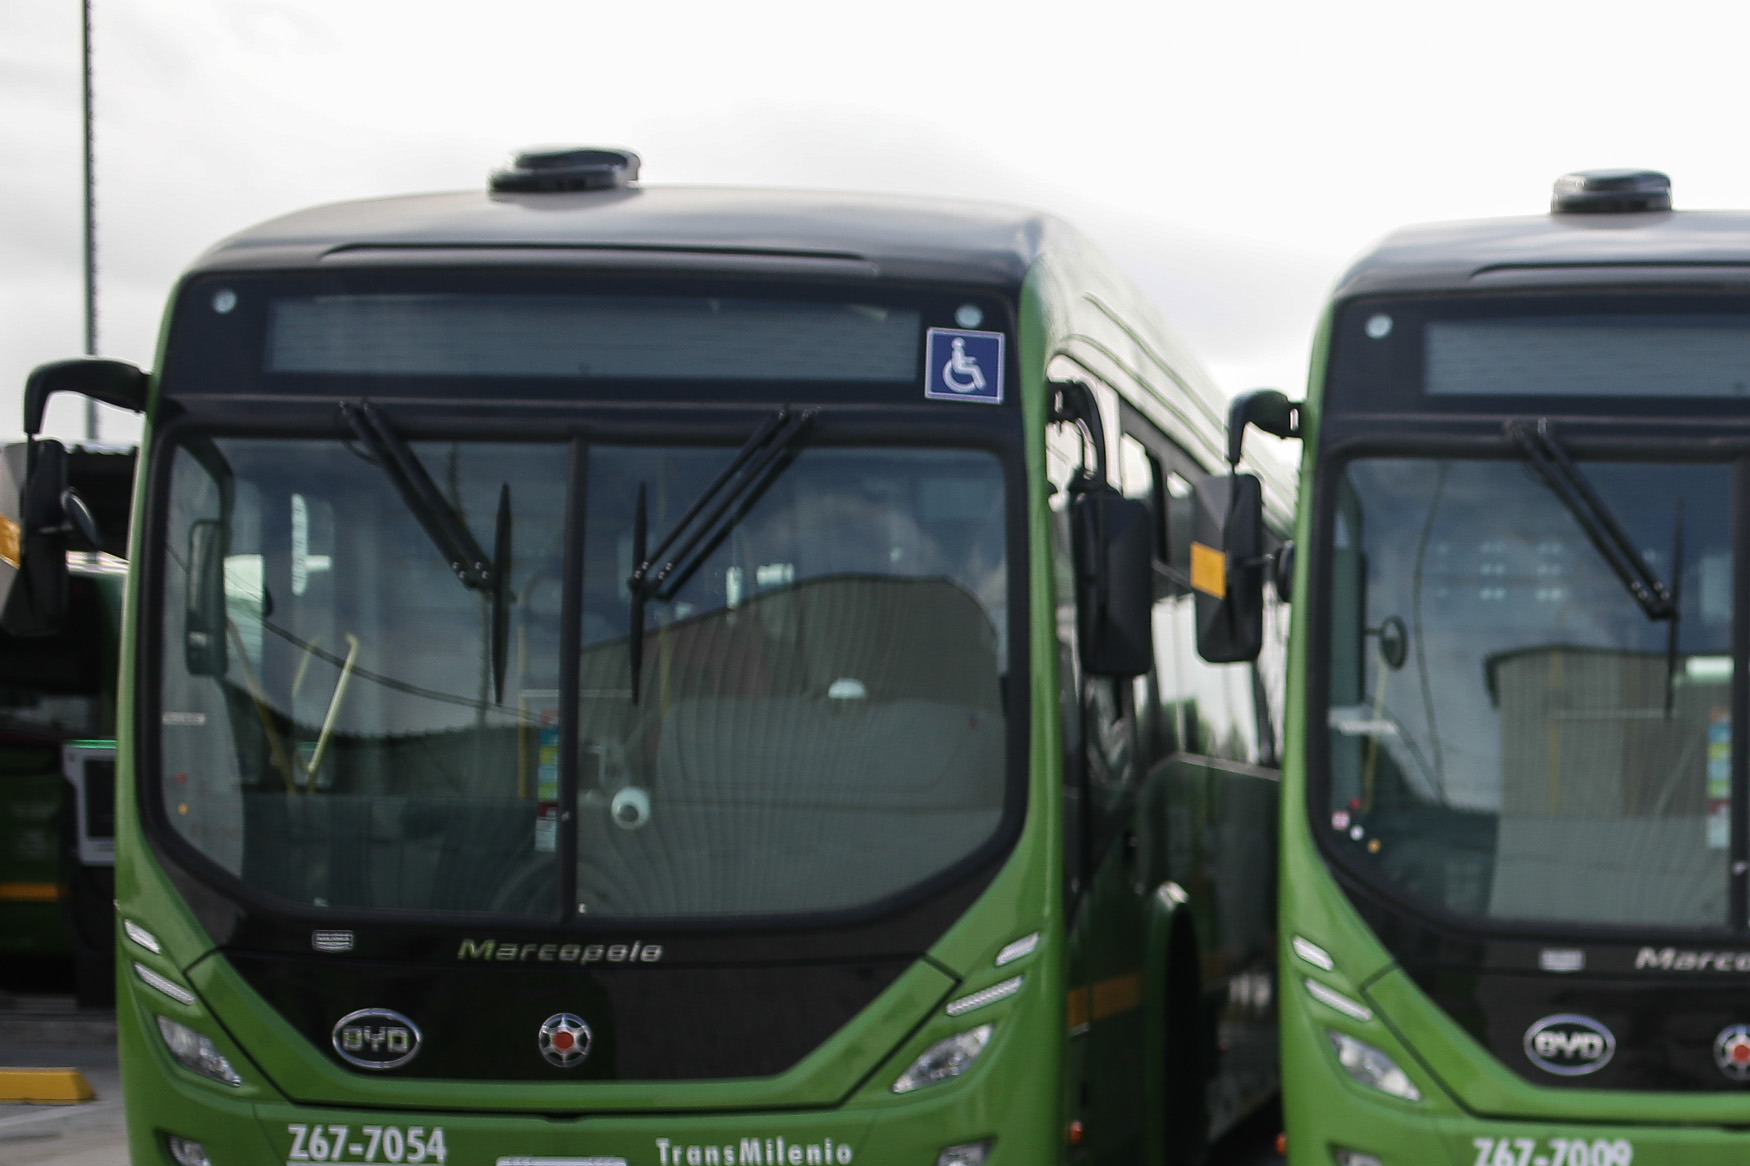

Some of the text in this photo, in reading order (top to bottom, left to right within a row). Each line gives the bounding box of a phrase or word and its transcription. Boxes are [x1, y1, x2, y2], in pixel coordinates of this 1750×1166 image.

[457, 937, 664, 965] Marcopolo
[343, 1026, 410, 1054] BYD
[1536, 1032, 1604, 1058] BYD
[287, 1124, 447, 1163] Z67-7054
